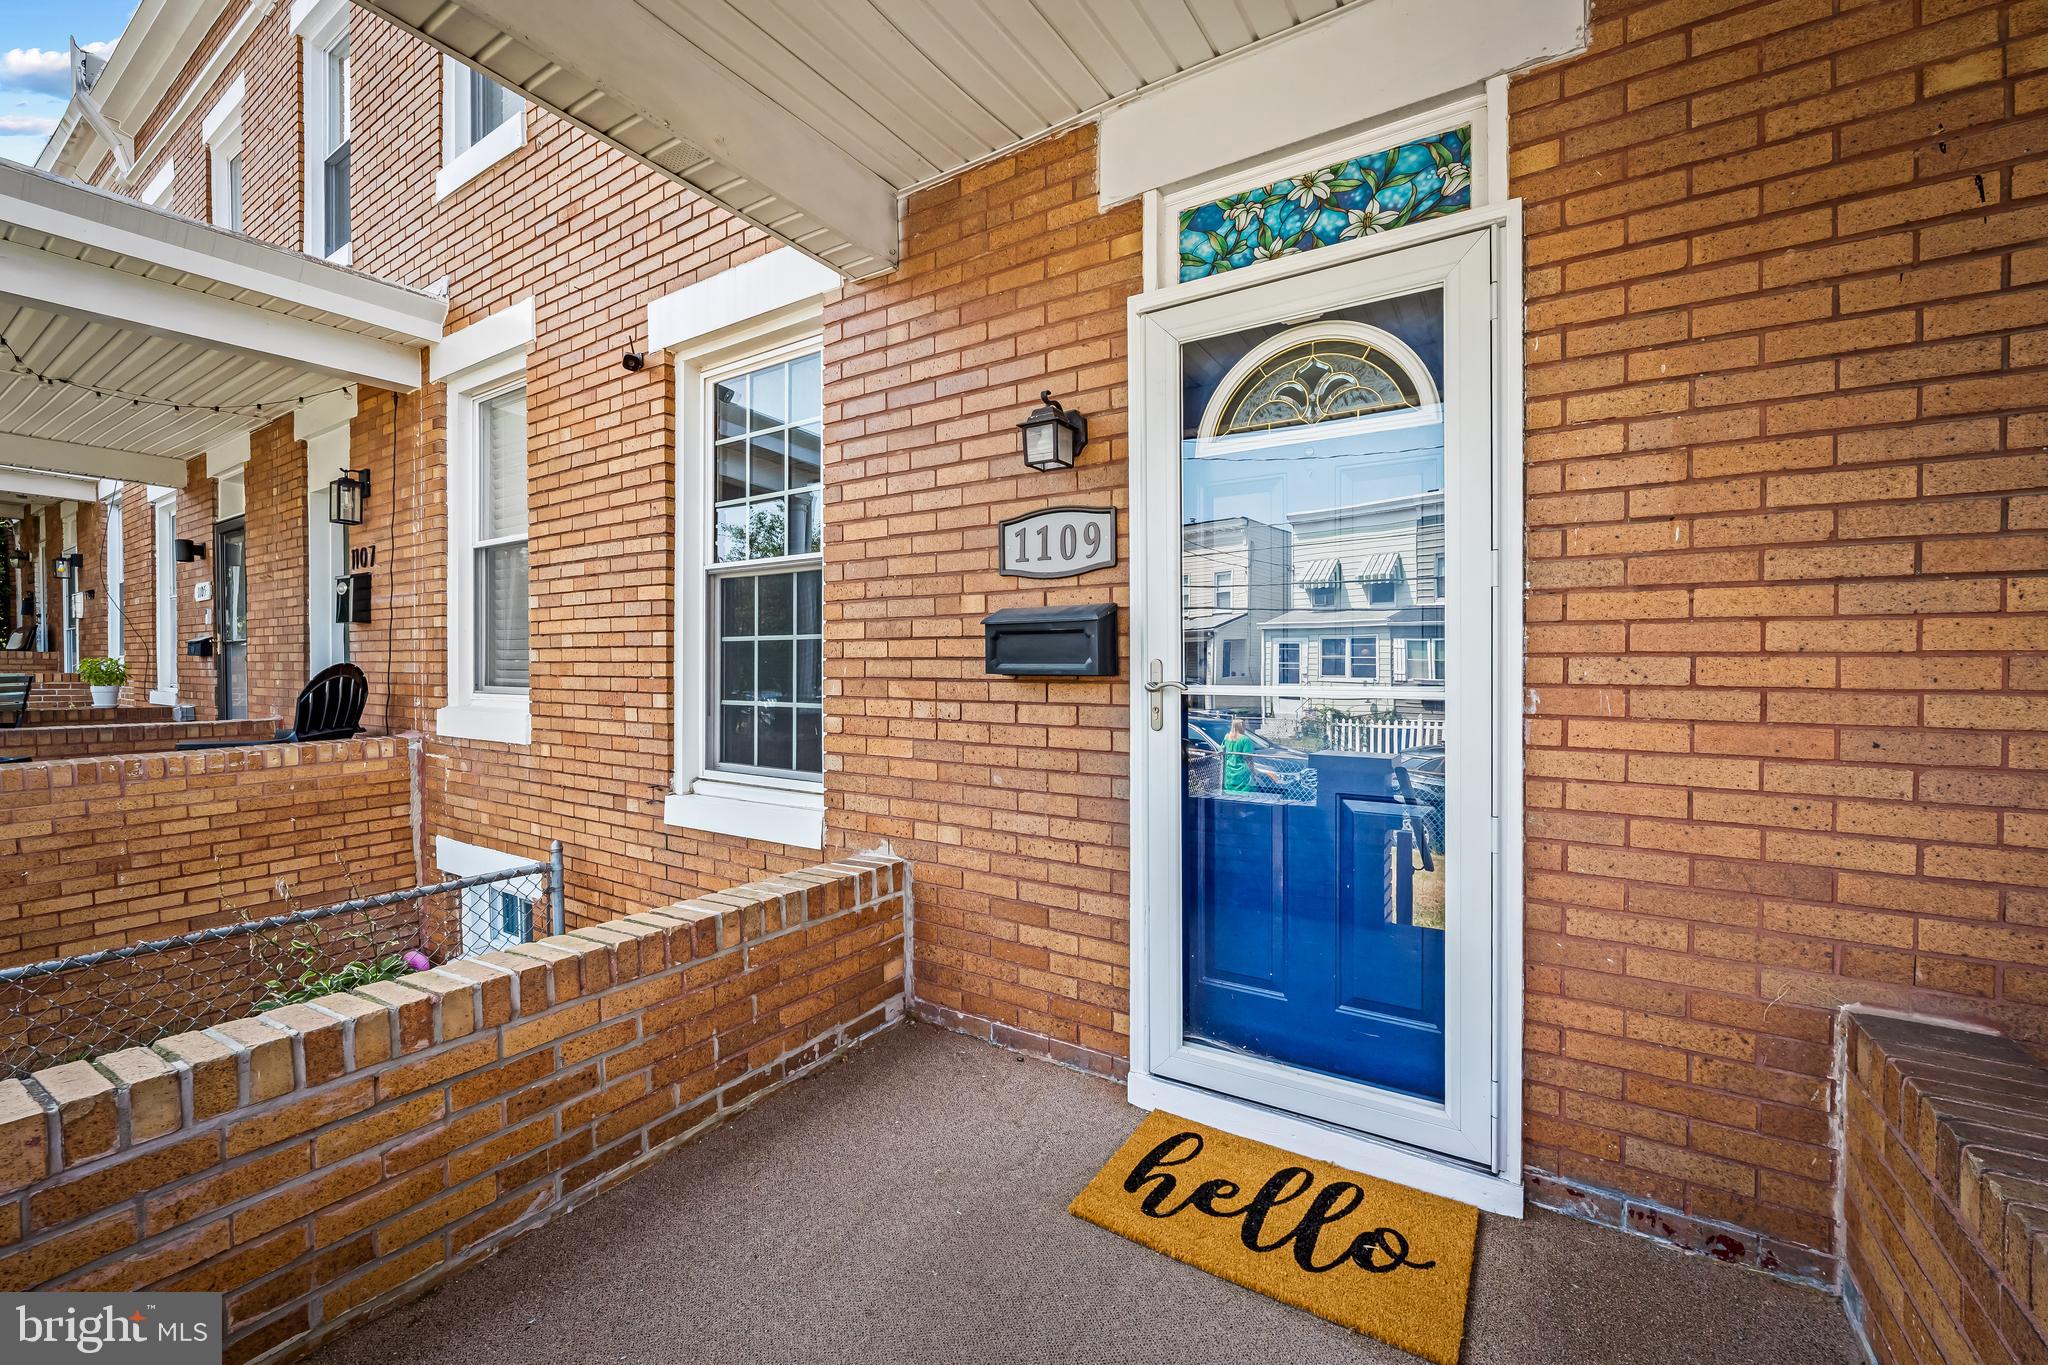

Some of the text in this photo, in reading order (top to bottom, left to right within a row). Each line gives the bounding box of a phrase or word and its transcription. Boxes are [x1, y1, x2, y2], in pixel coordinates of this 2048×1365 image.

[351, 545, 376, 570] 1107
[1014, 521, 1101, 563] 1109
[1123, 1132, 1436, 1274] hello
